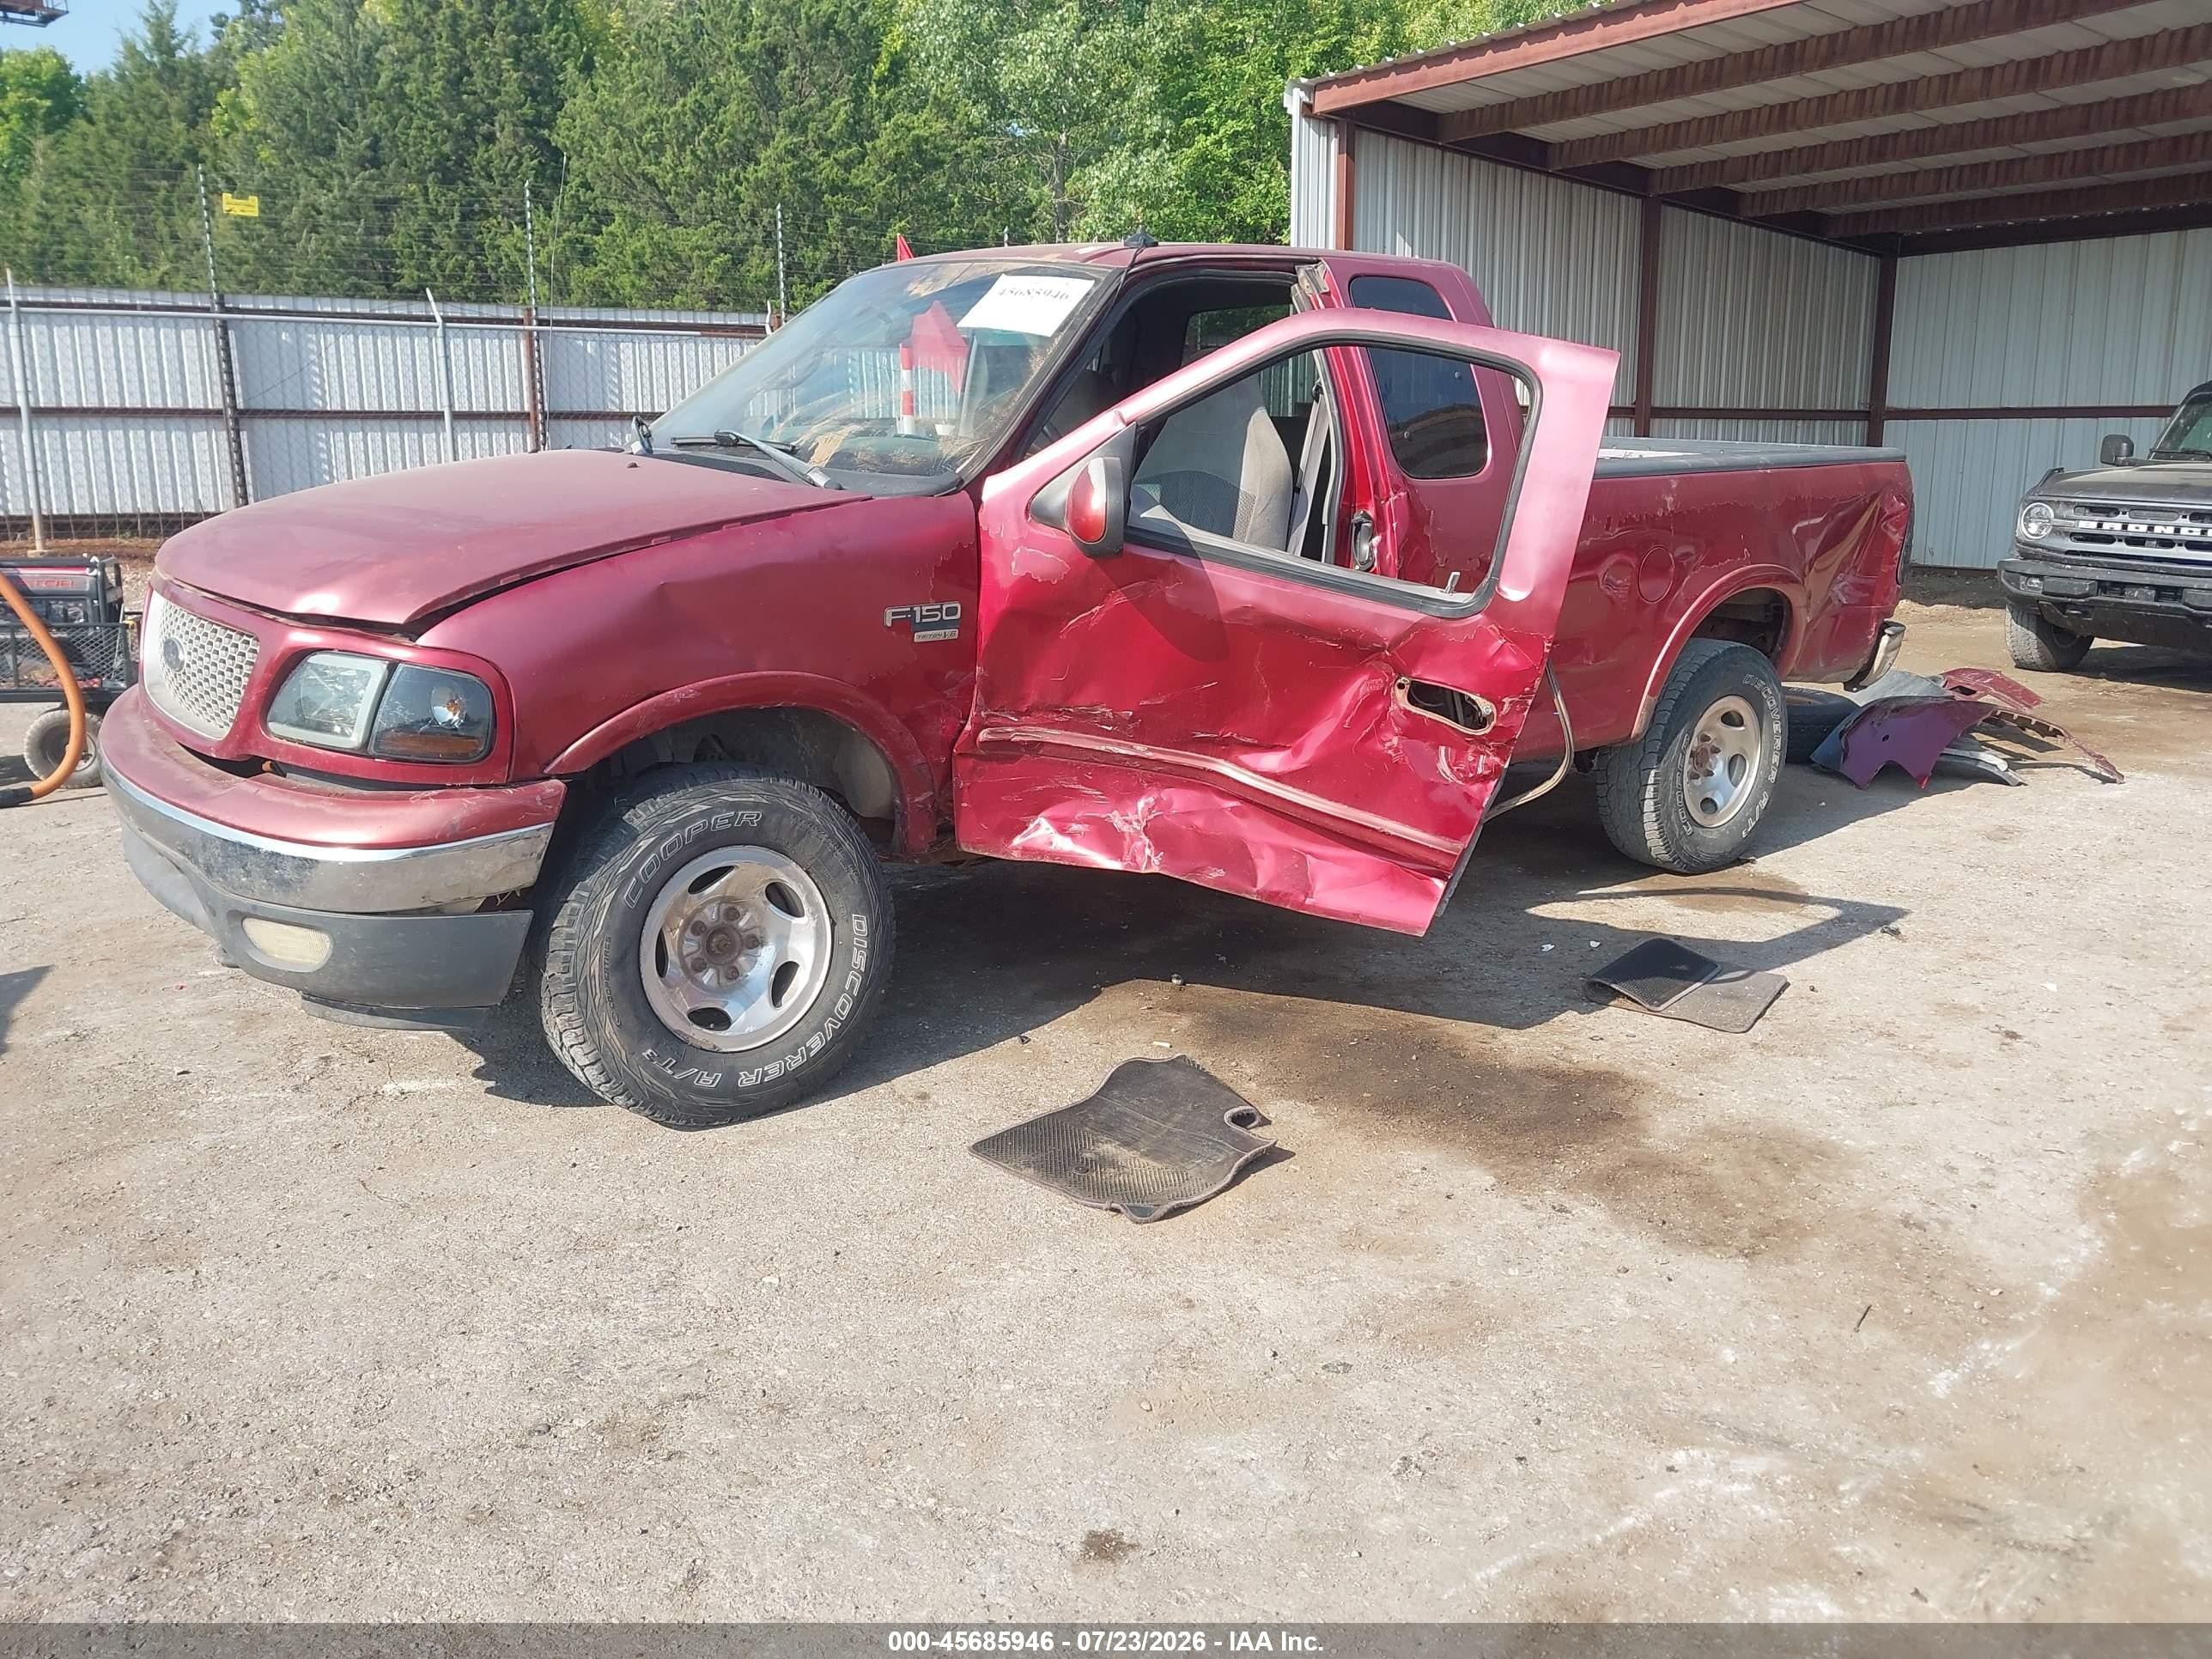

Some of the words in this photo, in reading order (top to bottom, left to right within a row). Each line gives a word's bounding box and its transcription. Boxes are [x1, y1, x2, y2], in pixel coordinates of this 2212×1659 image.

[2078, 520, 2212, 538] BRONC
[884, 602, 962, 627] F-150
[1741, 673, 1782, 783] DISCOVERER
[623, 811, 763, 909] COOPER
[738, 913, 868, 1088] DISCOVERER
